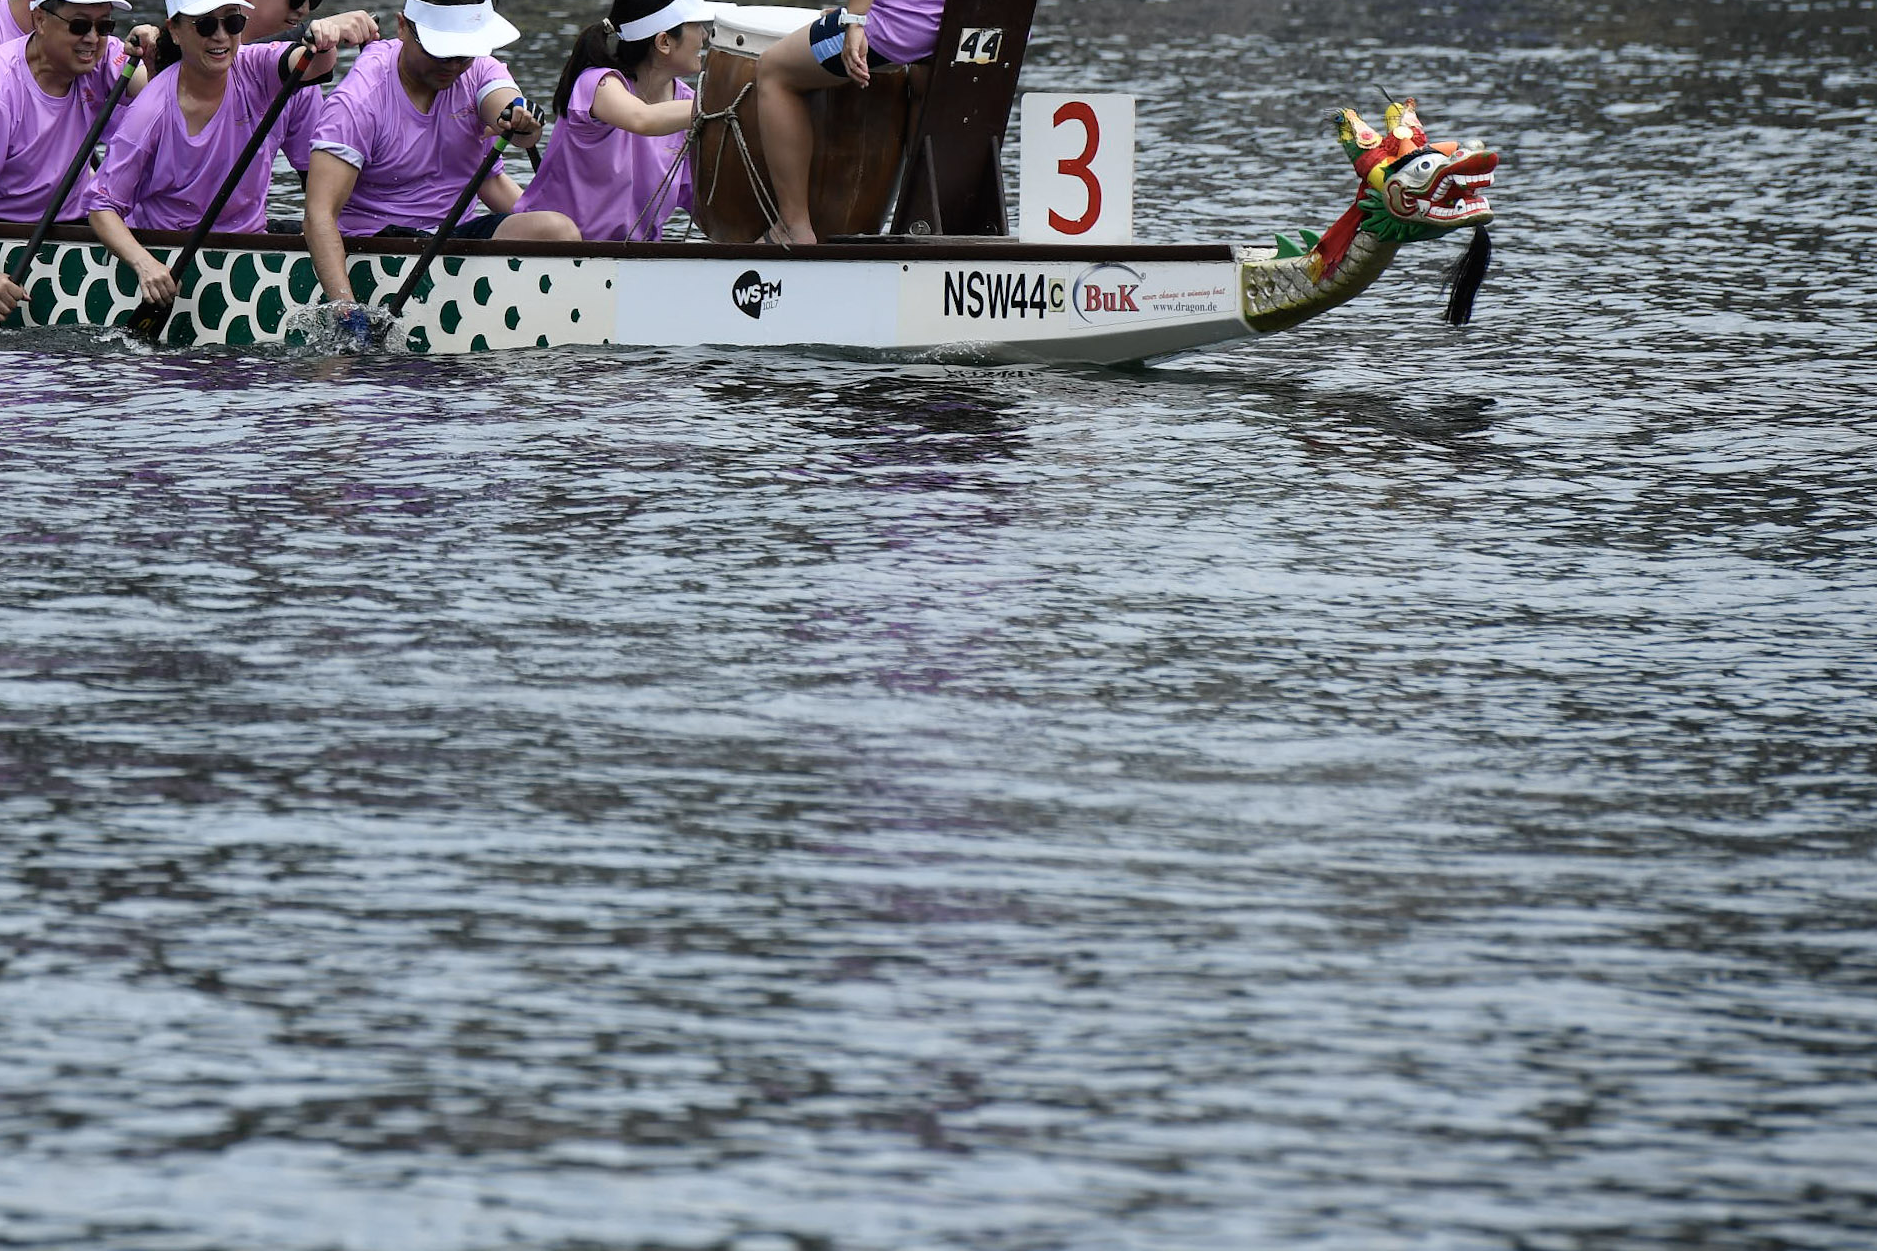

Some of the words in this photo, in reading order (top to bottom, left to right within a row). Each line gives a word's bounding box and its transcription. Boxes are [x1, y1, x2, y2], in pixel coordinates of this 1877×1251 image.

[960, 31, 1001, 62] 44
[1047, 101, 1102, 236] 3
[735, 279, 783, 307] WSFM
[1084, 284, 1140, 312] BuK
[1153, 301, 1218, 313] www.dragon.de
